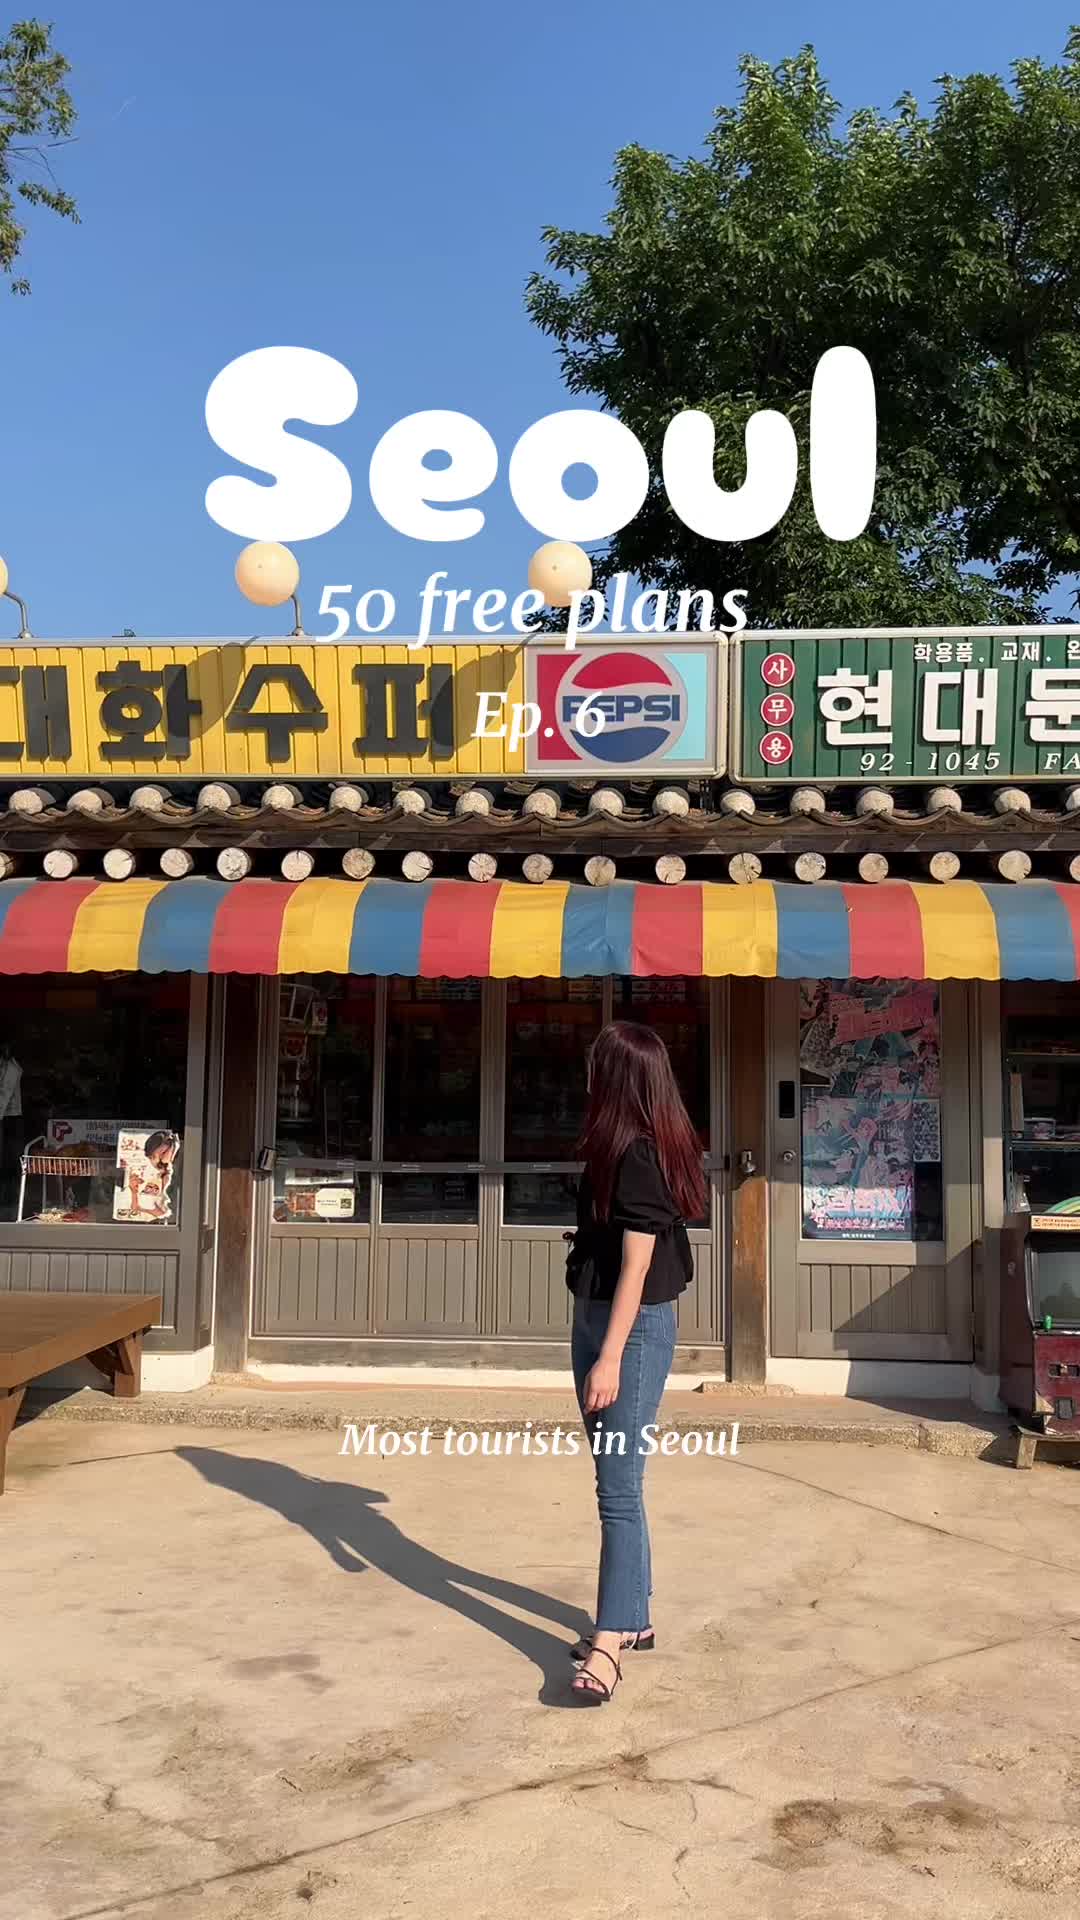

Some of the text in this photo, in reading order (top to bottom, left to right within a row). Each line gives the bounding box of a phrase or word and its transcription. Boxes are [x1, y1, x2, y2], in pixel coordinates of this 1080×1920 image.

[562, 694, 680, 722] PEPSI
[860, 752, 895, 771] 92
[927, 752, 1001, 771] 1045
